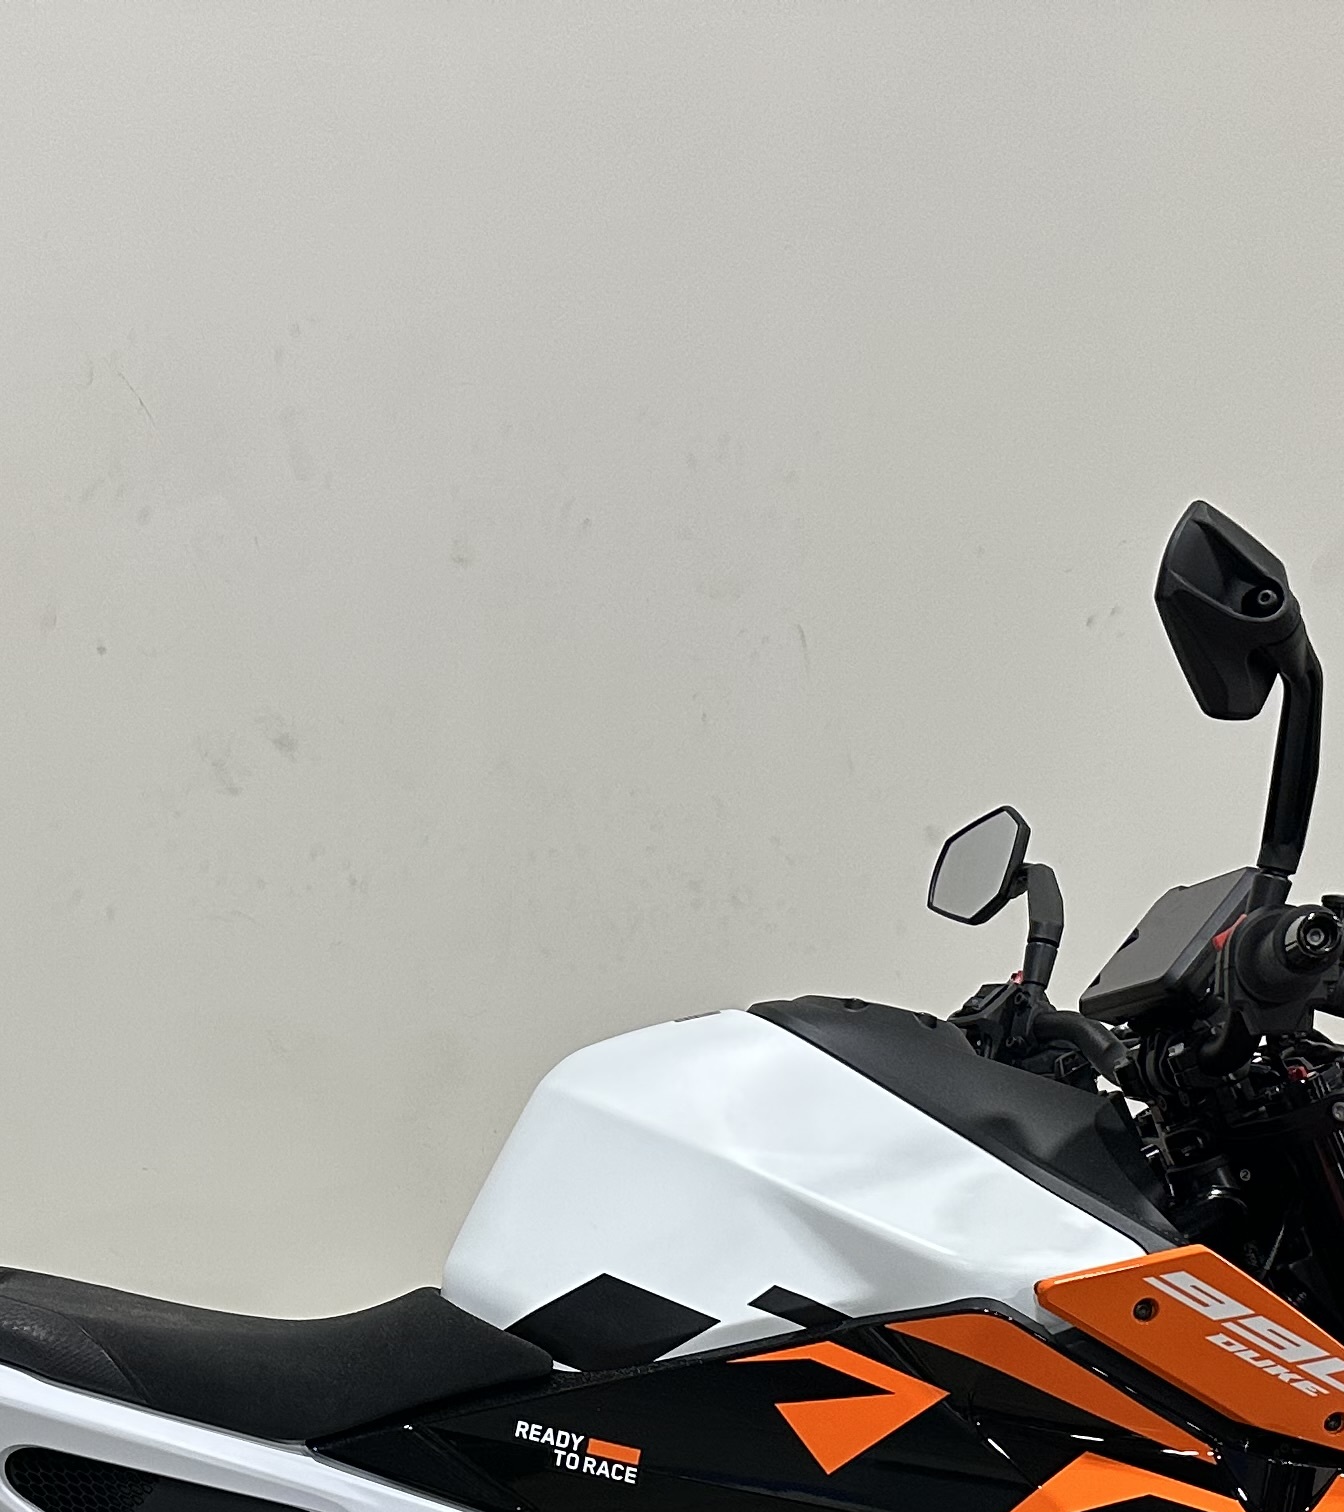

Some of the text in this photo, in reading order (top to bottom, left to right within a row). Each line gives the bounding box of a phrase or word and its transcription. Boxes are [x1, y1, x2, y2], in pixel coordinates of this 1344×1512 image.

[1205, 1333, 1329, 1397] DUKE
[514, 1420, 586, 1450] READY
[553, 1449, 639, 1484] TO RACE
